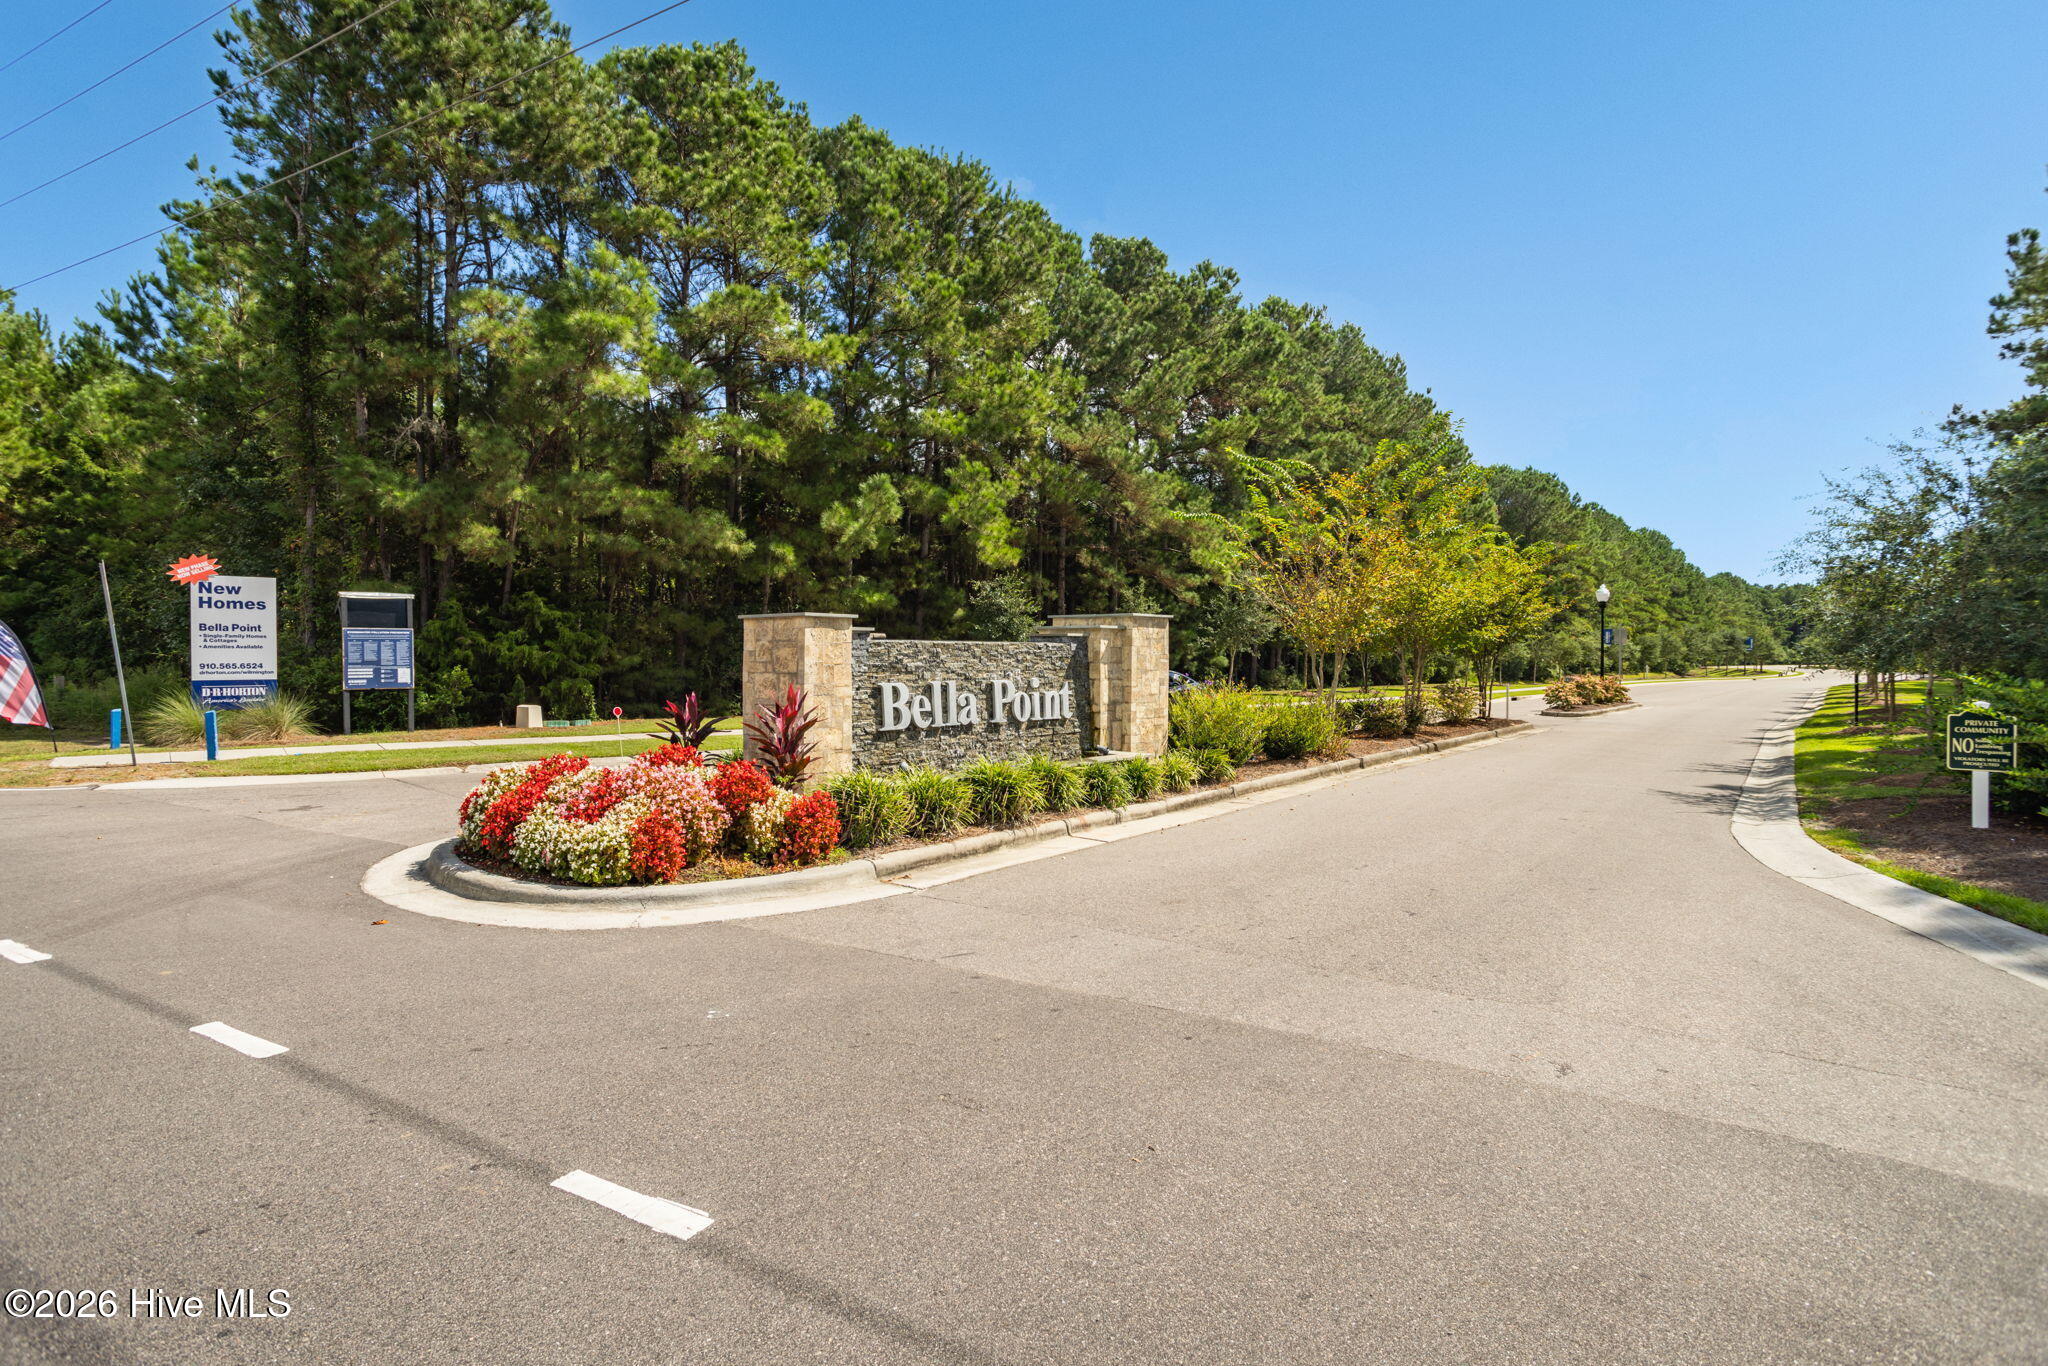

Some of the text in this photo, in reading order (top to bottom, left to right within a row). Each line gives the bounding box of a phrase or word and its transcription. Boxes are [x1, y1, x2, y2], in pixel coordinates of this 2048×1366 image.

[198, 581, 242, 594] New
[198, 597, 267, 610] Homes
[199, 623, 262, 632] Bella Point
[878, 677, 1074, 731] Bella Point
[1954, 726, 2009, 734] COMMUNITY
[1952, 737, 1974, 753] NO
